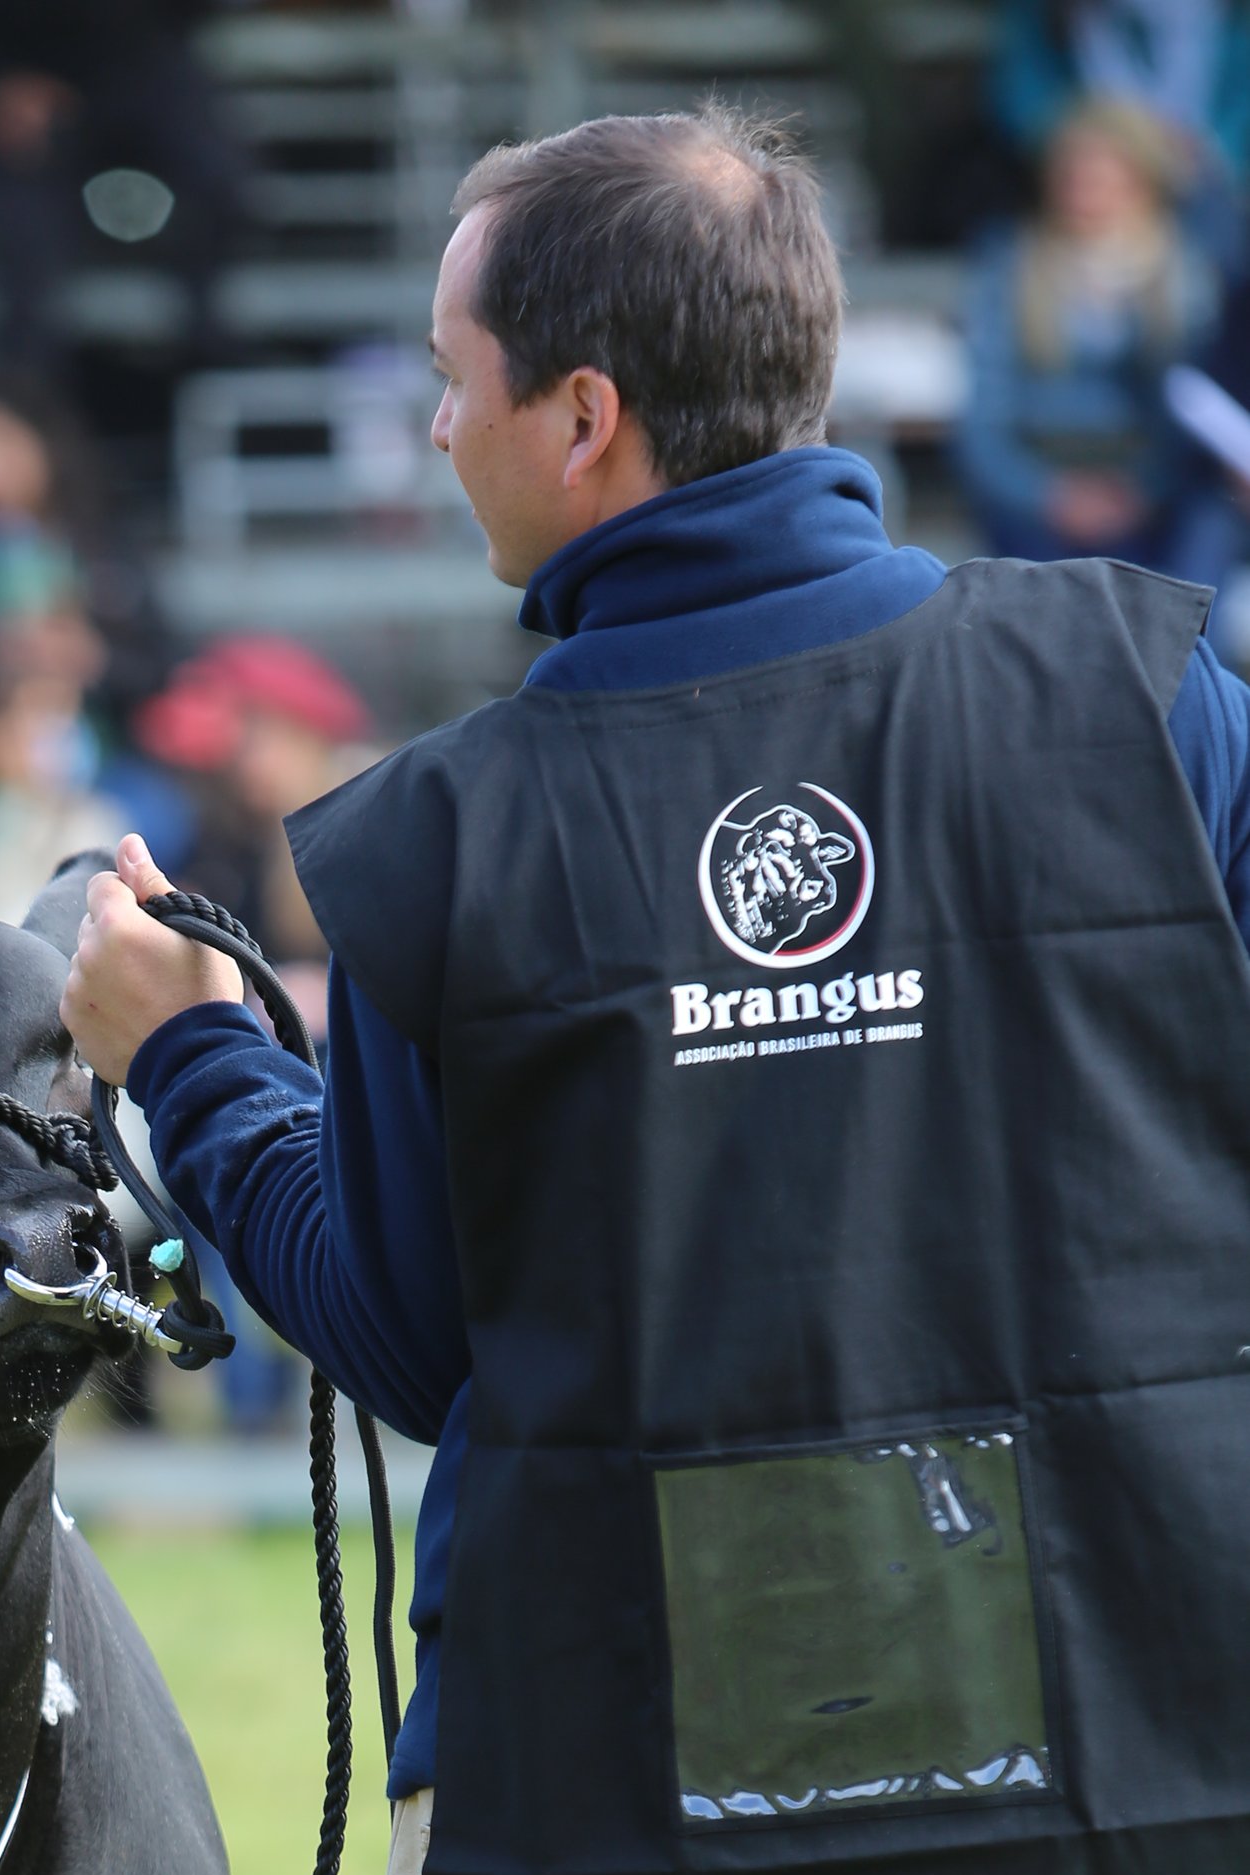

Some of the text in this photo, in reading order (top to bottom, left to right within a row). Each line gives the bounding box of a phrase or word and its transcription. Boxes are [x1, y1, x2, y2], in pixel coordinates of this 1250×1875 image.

[670, 969, 924, 1035] Brangus
[674, 1023, 924, 1066] ASSOCIAÇÃO BRASILEIRA DE BRANGUS
